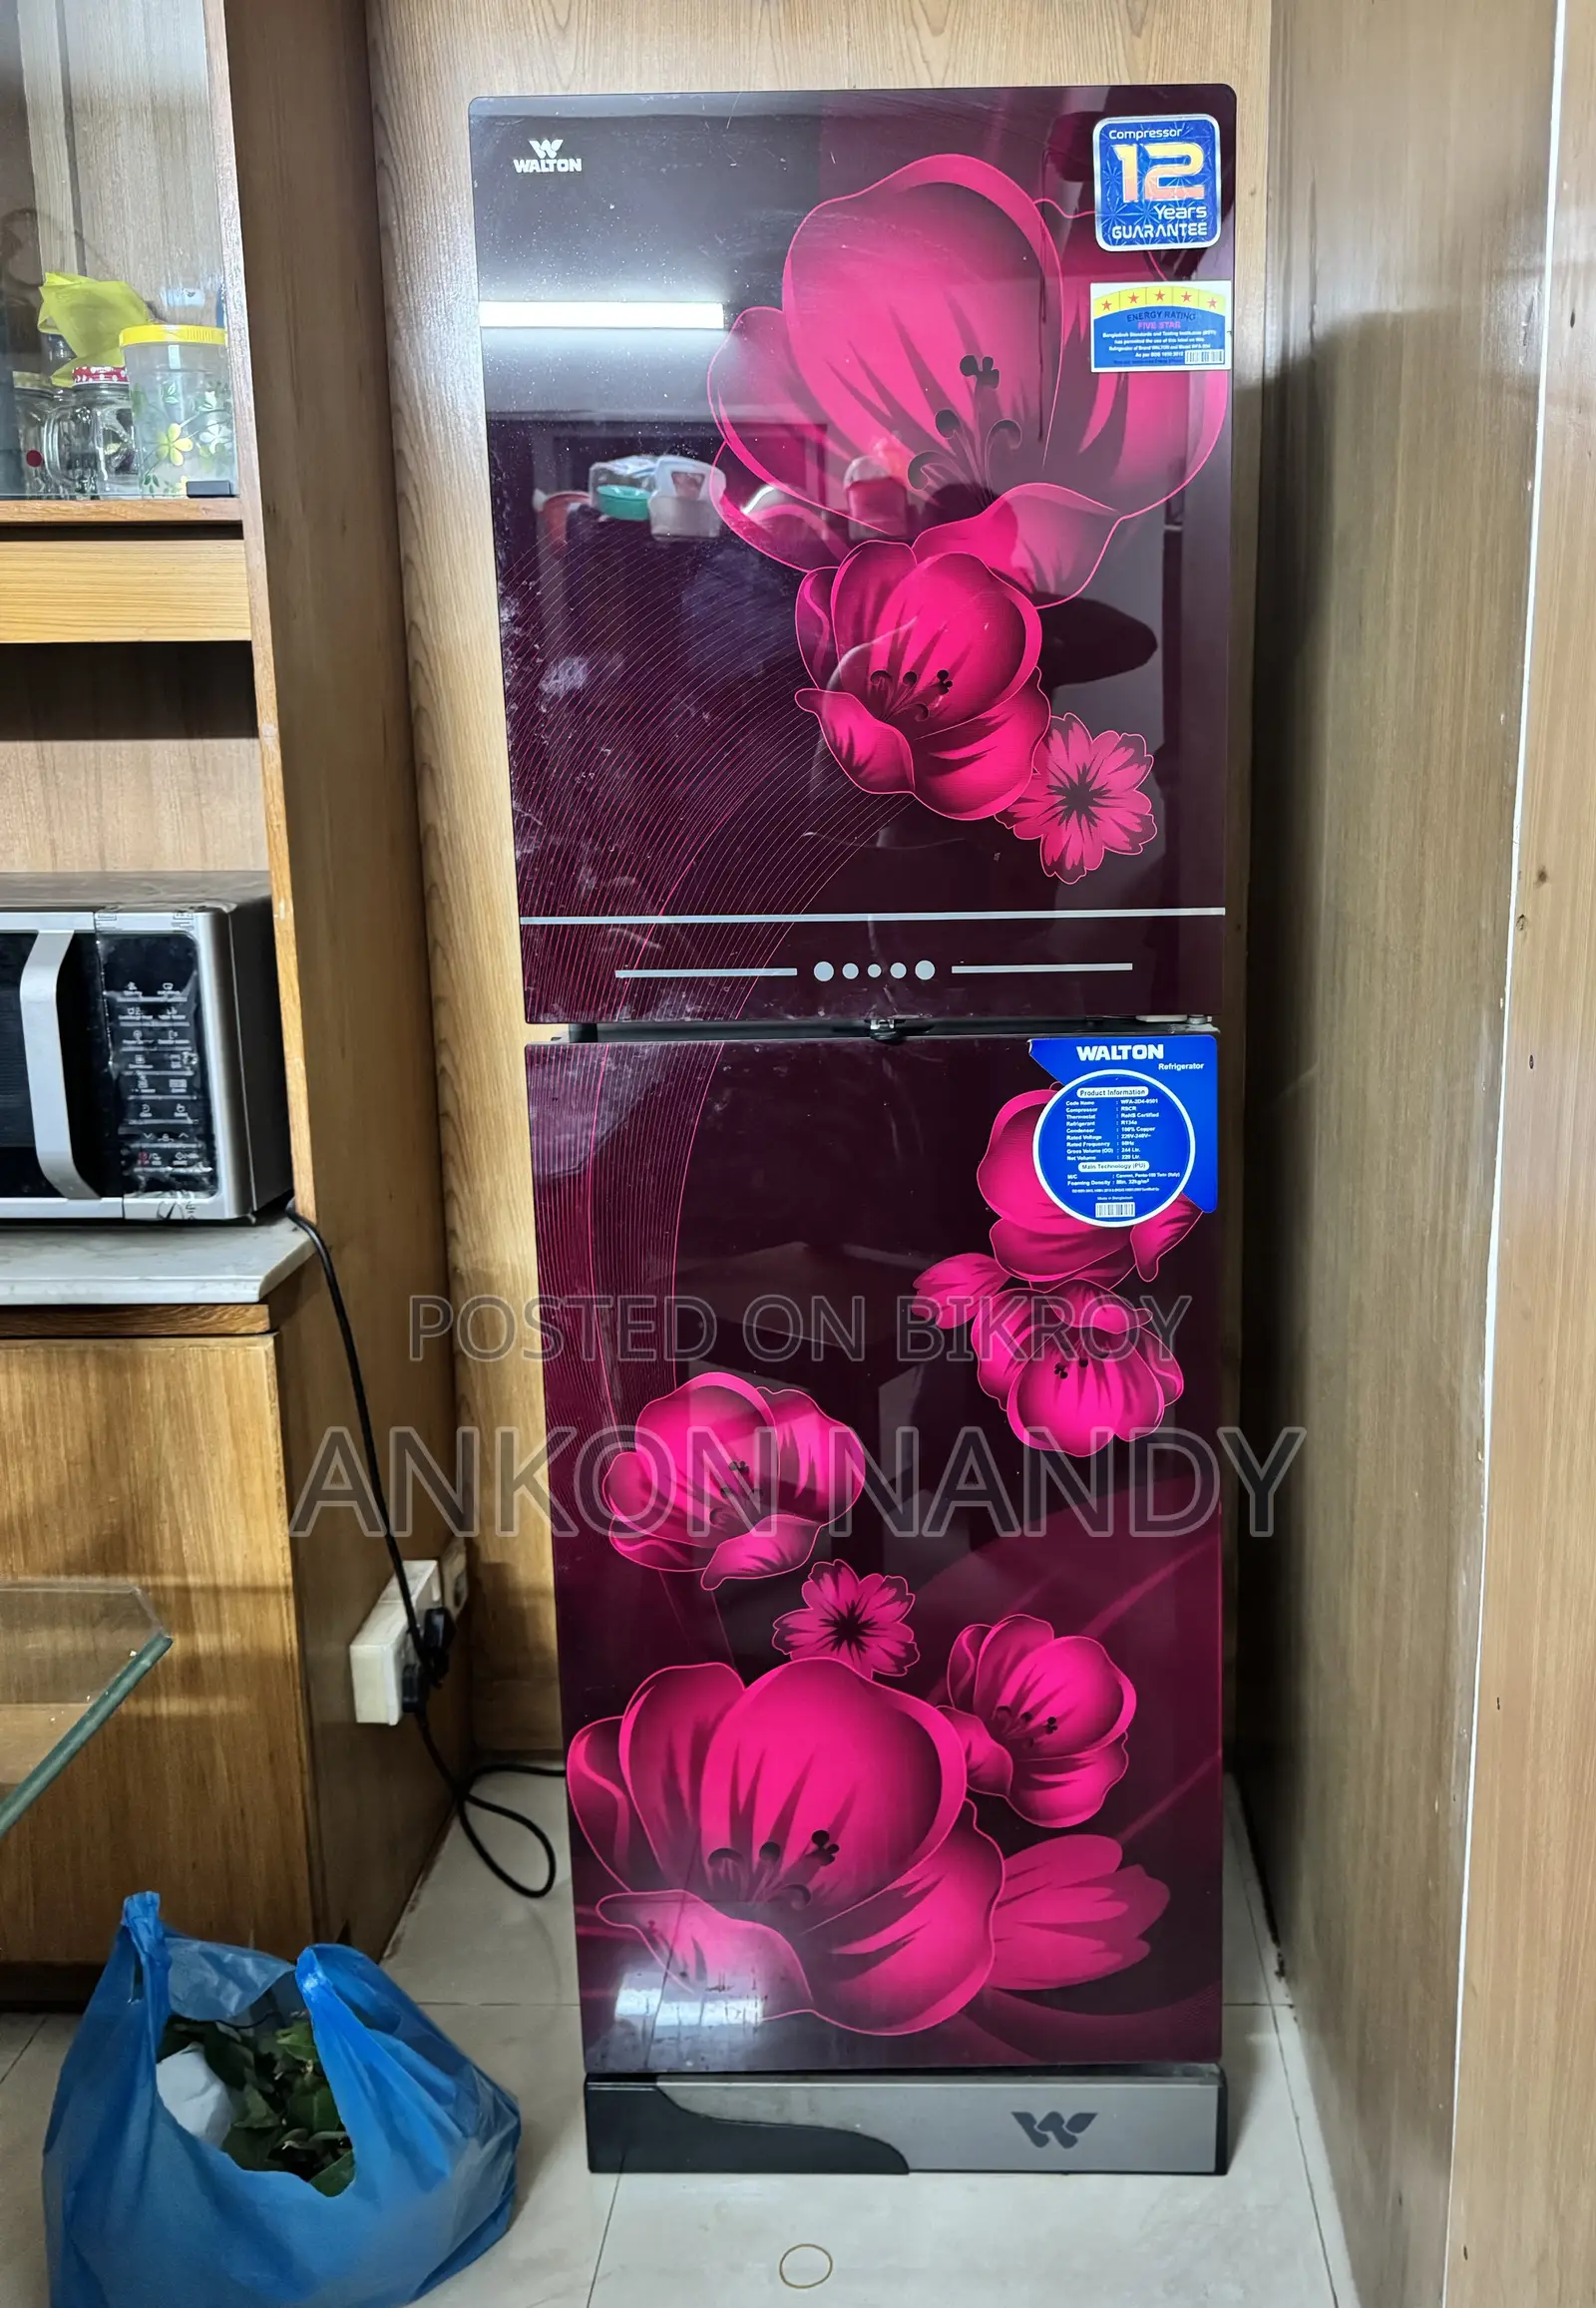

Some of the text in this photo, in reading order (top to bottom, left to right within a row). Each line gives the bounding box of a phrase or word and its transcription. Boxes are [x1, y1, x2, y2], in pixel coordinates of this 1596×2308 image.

[1109, 129, 1183, 141] Compressor
[513, 158, 582, 173] WALTON
[1110, 142, 1205, 202] 12
[1153, 205, 1207, 220] Years
[1112, 222, 1207, 239] GUARANTEE
[1127, 311, 1196, 322] ENERGY RATING
[1158, 321, 1181, 329] STAR
[1076, 1044, 1164, 1061] WALTON
[1158, 1062, 1204, 1071] Refrigerator
